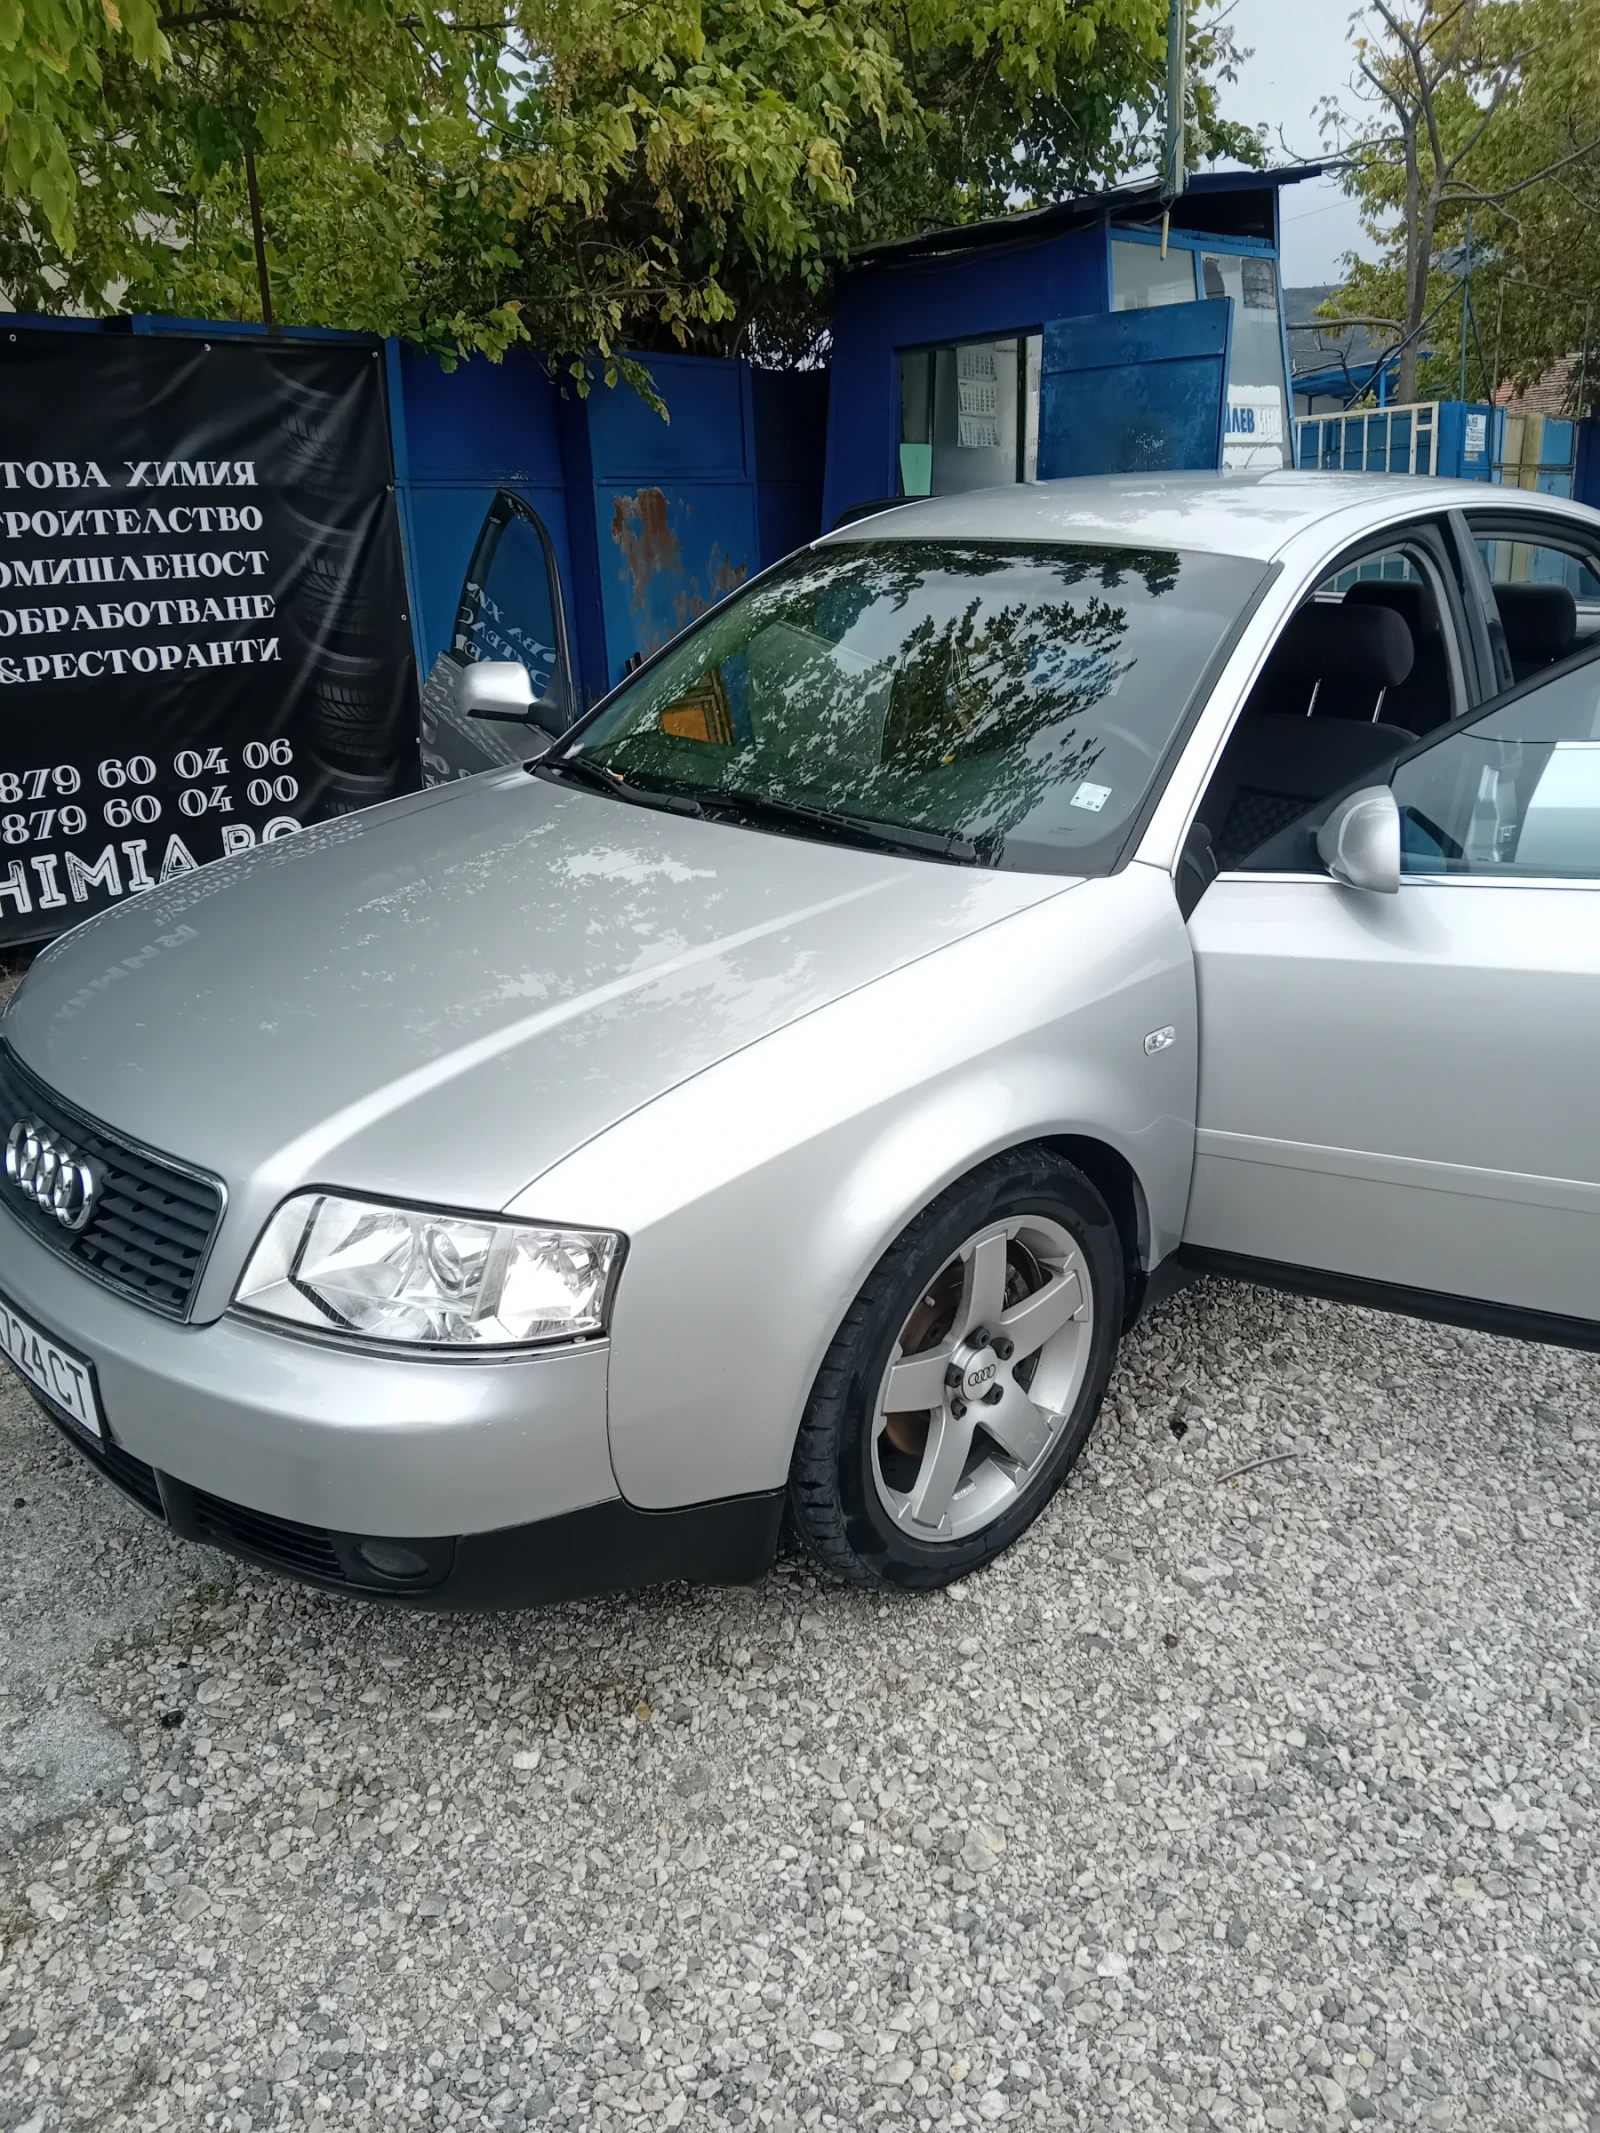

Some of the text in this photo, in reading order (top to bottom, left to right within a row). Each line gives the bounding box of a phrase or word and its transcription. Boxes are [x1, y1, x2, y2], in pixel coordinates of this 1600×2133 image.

[123, 461, 259, 487] ХИМИЯ
[0, 505, 263, 538] РОИТЕЛСТВО
[0, 594, 276, 636] ОБРАБОТВАНЕ
[0, 738, 293, 804] 879 60 04 06
[1, 775, 299, 844] 879 60 04 00
